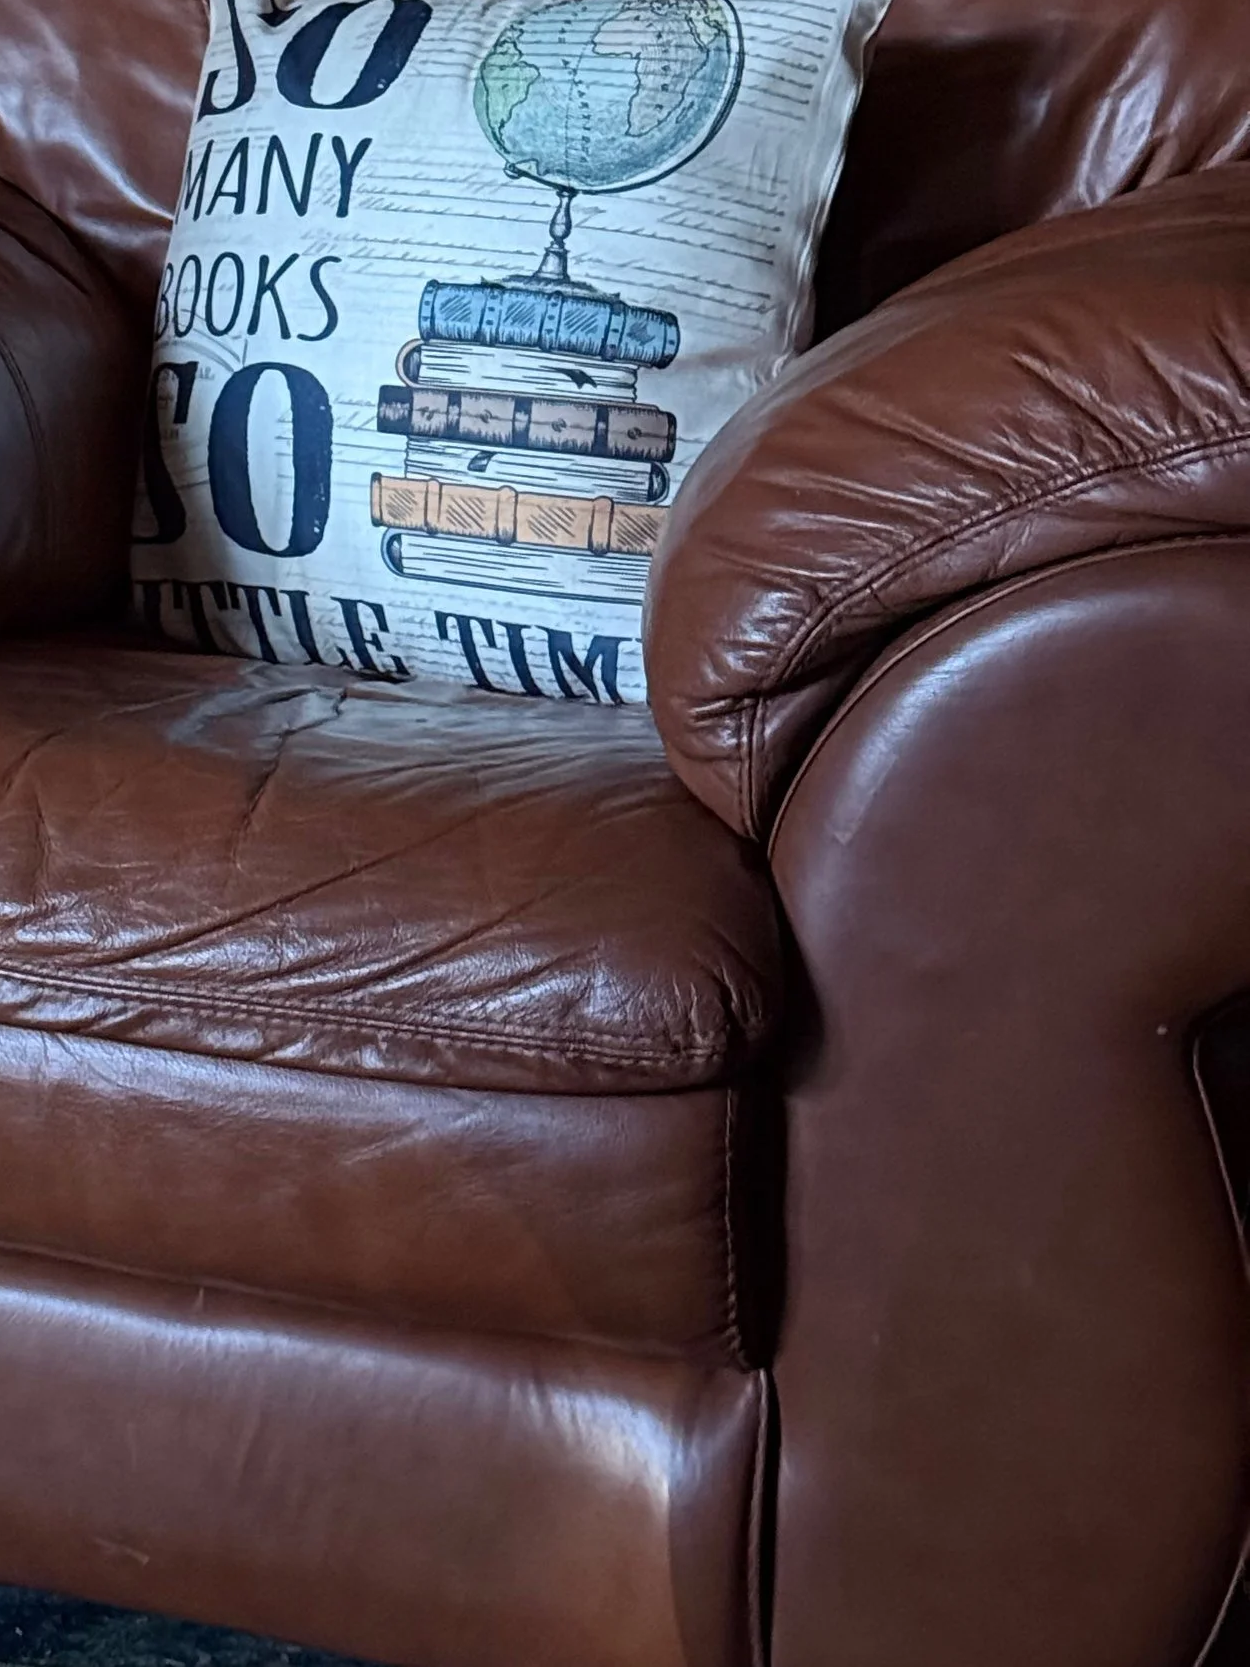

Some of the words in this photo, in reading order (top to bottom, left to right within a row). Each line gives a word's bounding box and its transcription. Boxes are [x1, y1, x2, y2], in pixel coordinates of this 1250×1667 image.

[178, 132, 373, 224] MANY
[155, 251, 344, 343] BOOKS
[132, 360, 334, 558] SO
[434, 610, 648, 706] TIM
